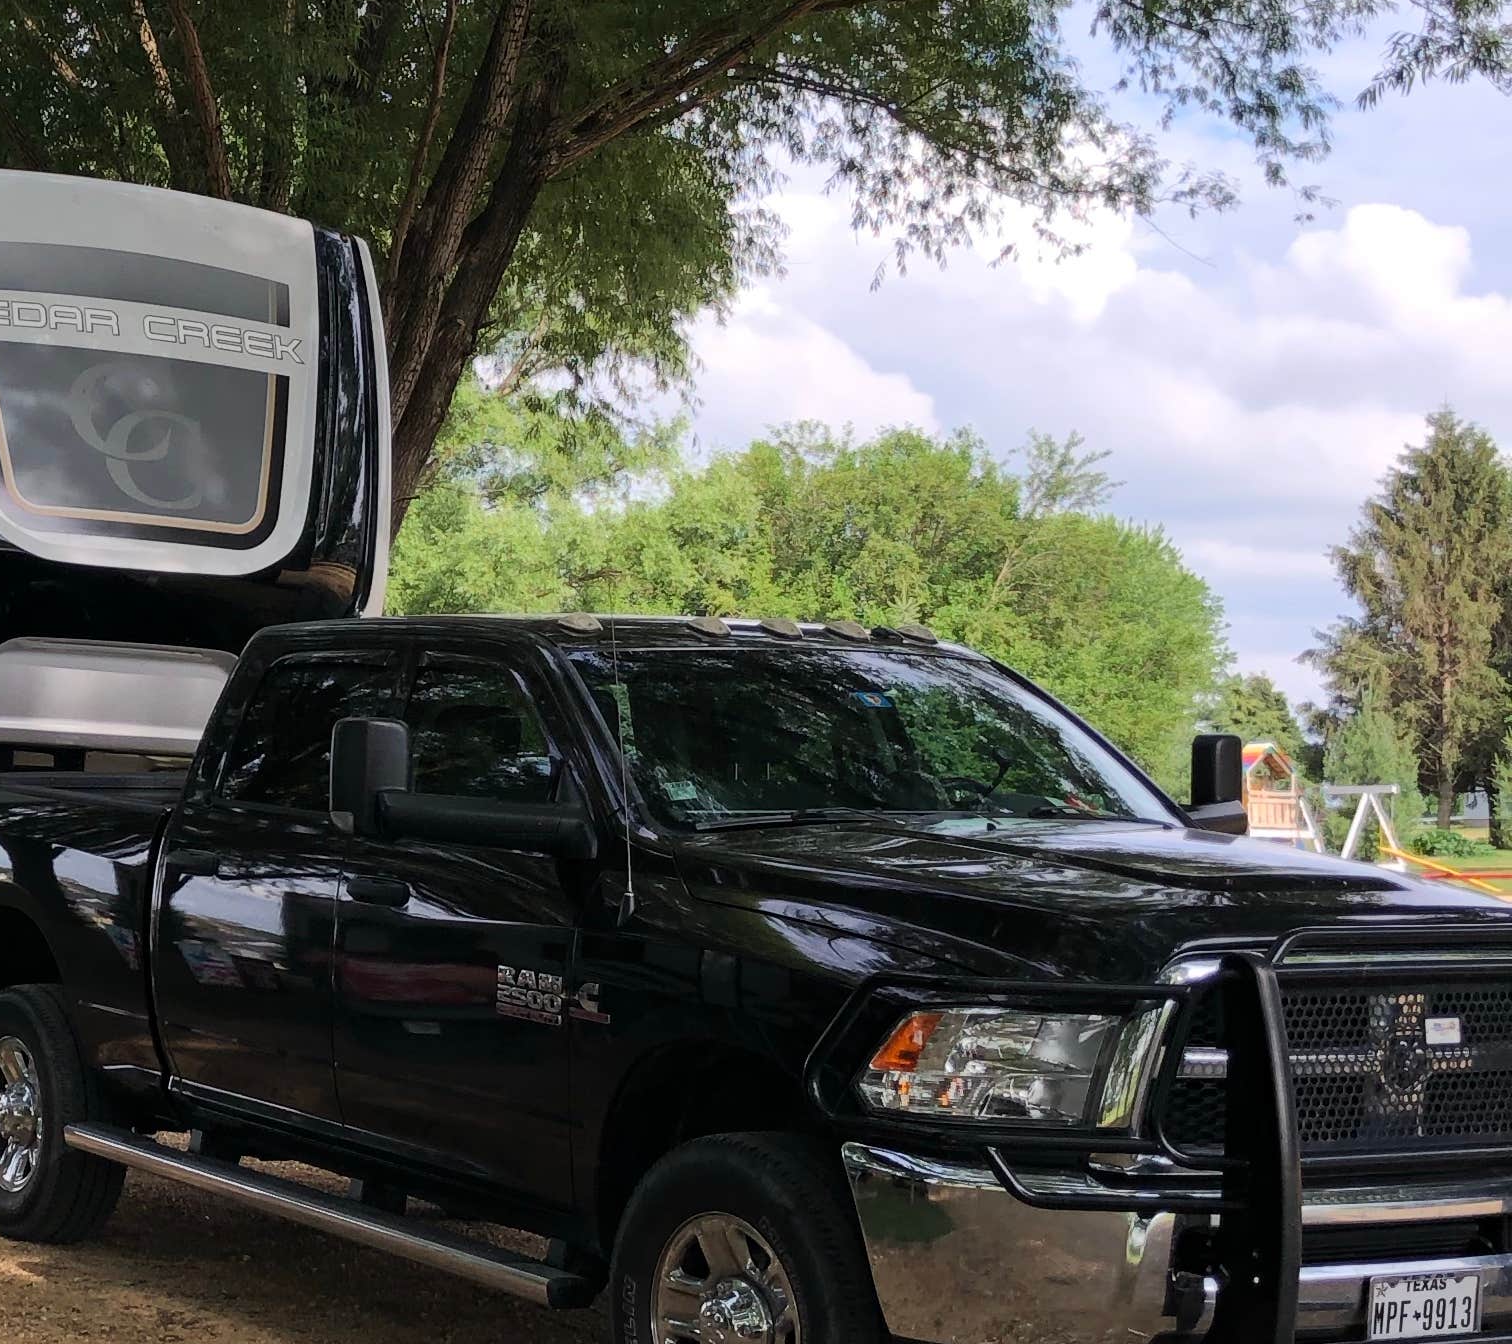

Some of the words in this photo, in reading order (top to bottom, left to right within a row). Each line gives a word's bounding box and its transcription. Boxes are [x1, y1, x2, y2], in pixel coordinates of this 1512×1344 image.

[143, 314, 305, 364] CREEK
[497, 964, 563, 993] RAM
[496, 983, 562, 1013] 2500
[1406, 1278, 1448, 1293] TEXAS
